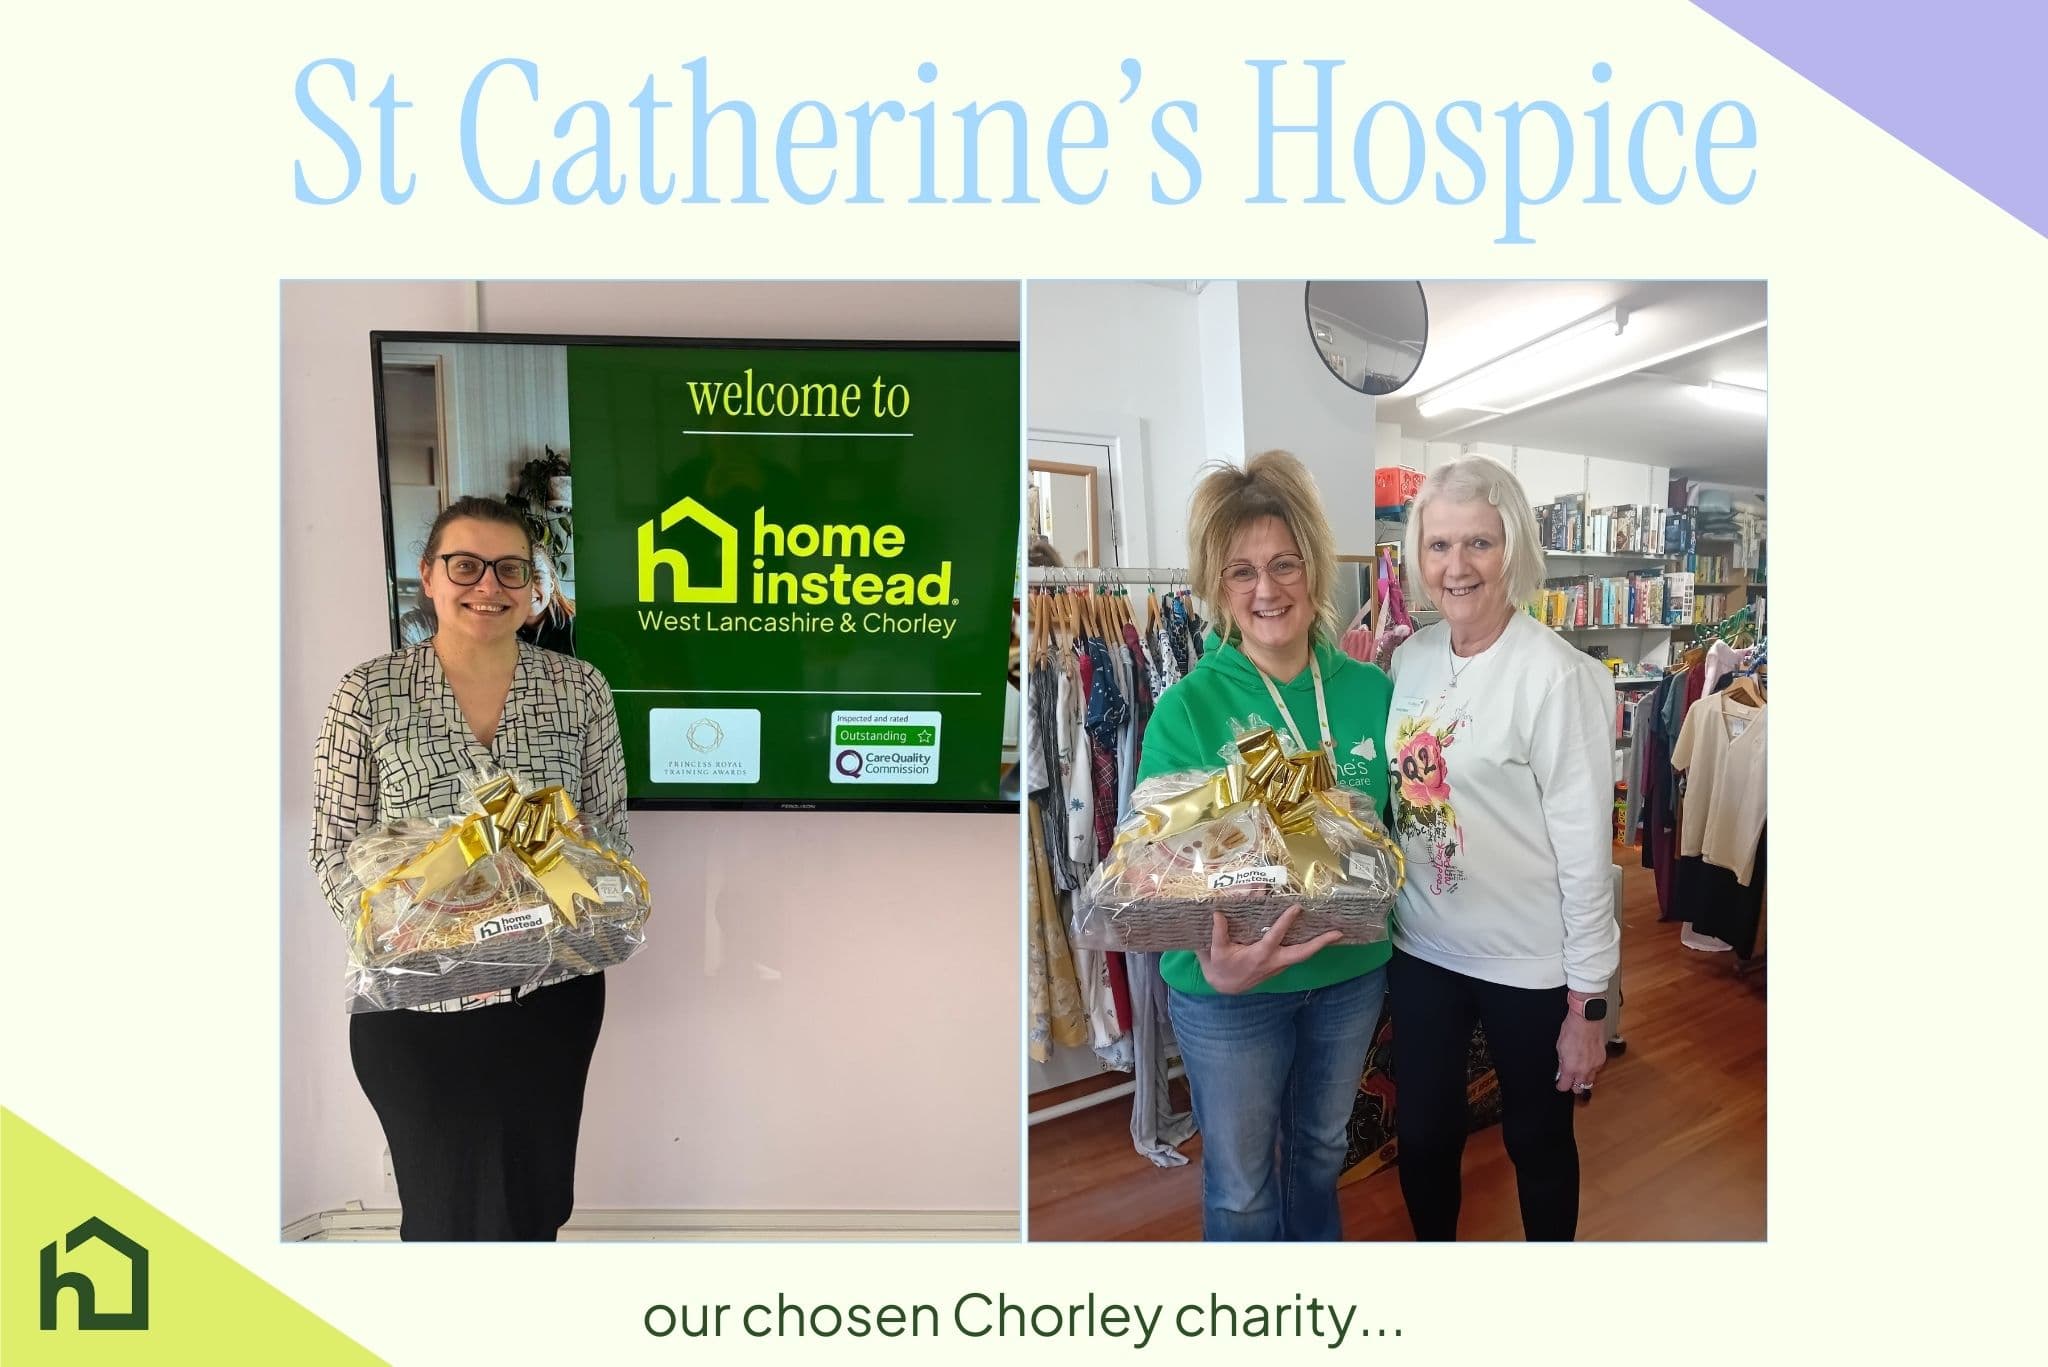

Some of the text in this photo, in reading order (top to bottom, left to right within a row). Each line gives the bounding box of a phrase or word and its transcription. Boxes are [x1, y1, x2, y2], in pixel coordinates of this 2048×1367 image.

[686, 368, 909, 417] welcome to
[754, 505, 905, 557] home
[638, 611, 956, 639] West Lancashire & Chorley
[837, 715, 872, 723] Inspected
[840, 730, 907, 743] Outstanding
[668, 760, 743, 768] PRINCESS ROYAL
[865, 764, 929, 774] Commission
[1348, 777, 1371, 787] care
[1235, 876, 1276, 884] instead
[1236, 870, 1267, 880] home
[501, 913, 531, 925] home
[503, 918, 543, 932] instead
